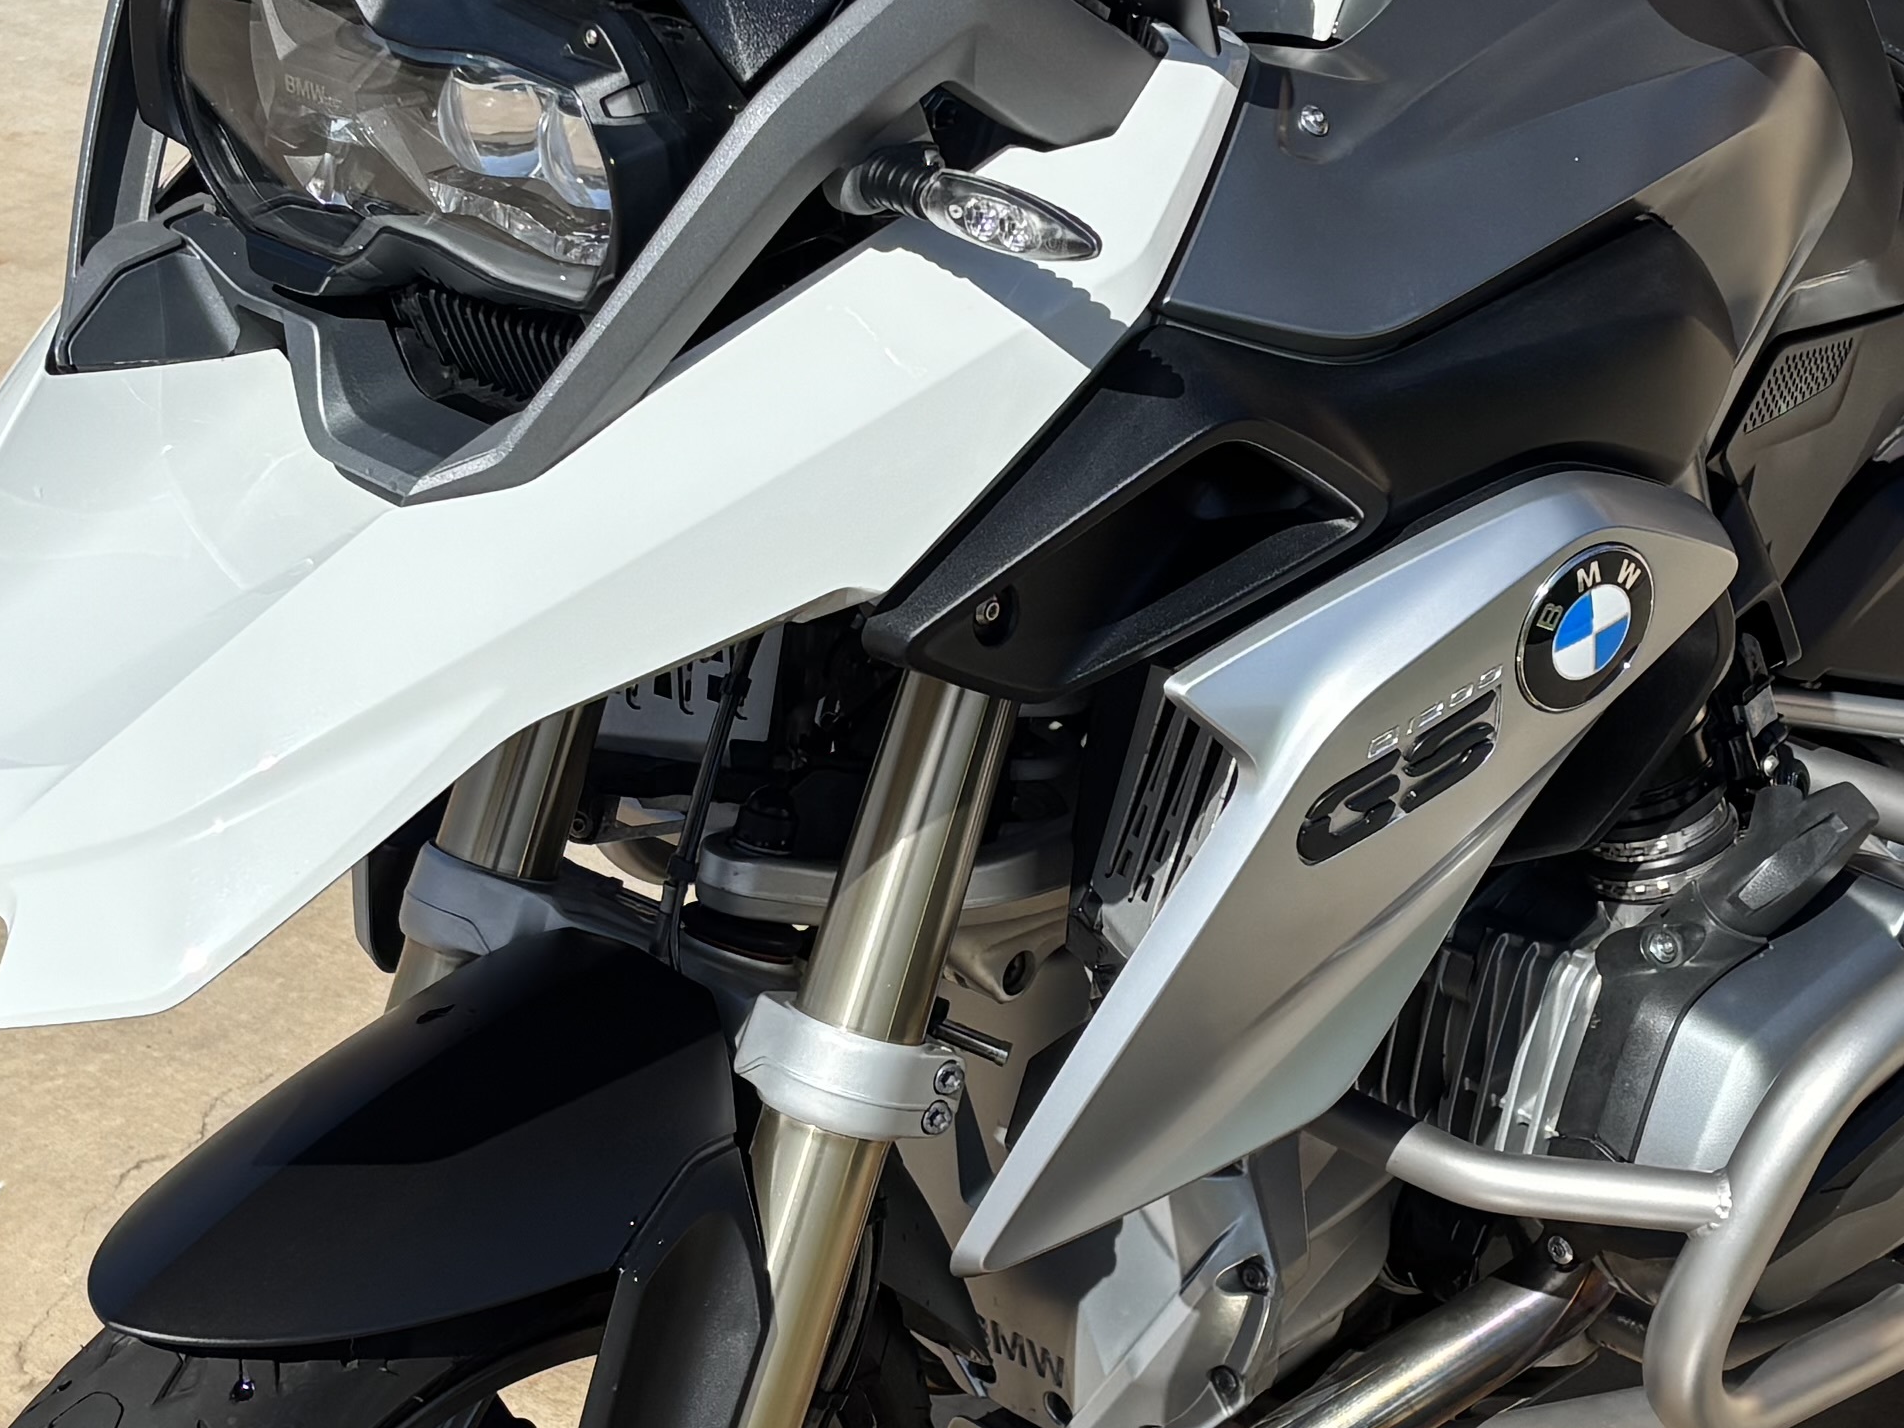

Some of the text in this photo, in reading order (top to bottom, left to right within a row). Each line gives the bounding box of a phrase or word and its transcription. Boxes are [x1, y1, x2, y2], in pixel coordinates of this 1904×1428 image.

[284, 73, 326, 105] BMW
[1536, 558, 1642, 632] BMW
[1296, 688, 1497, 866] GS
[977, 1313, 1065, 1389] MW
